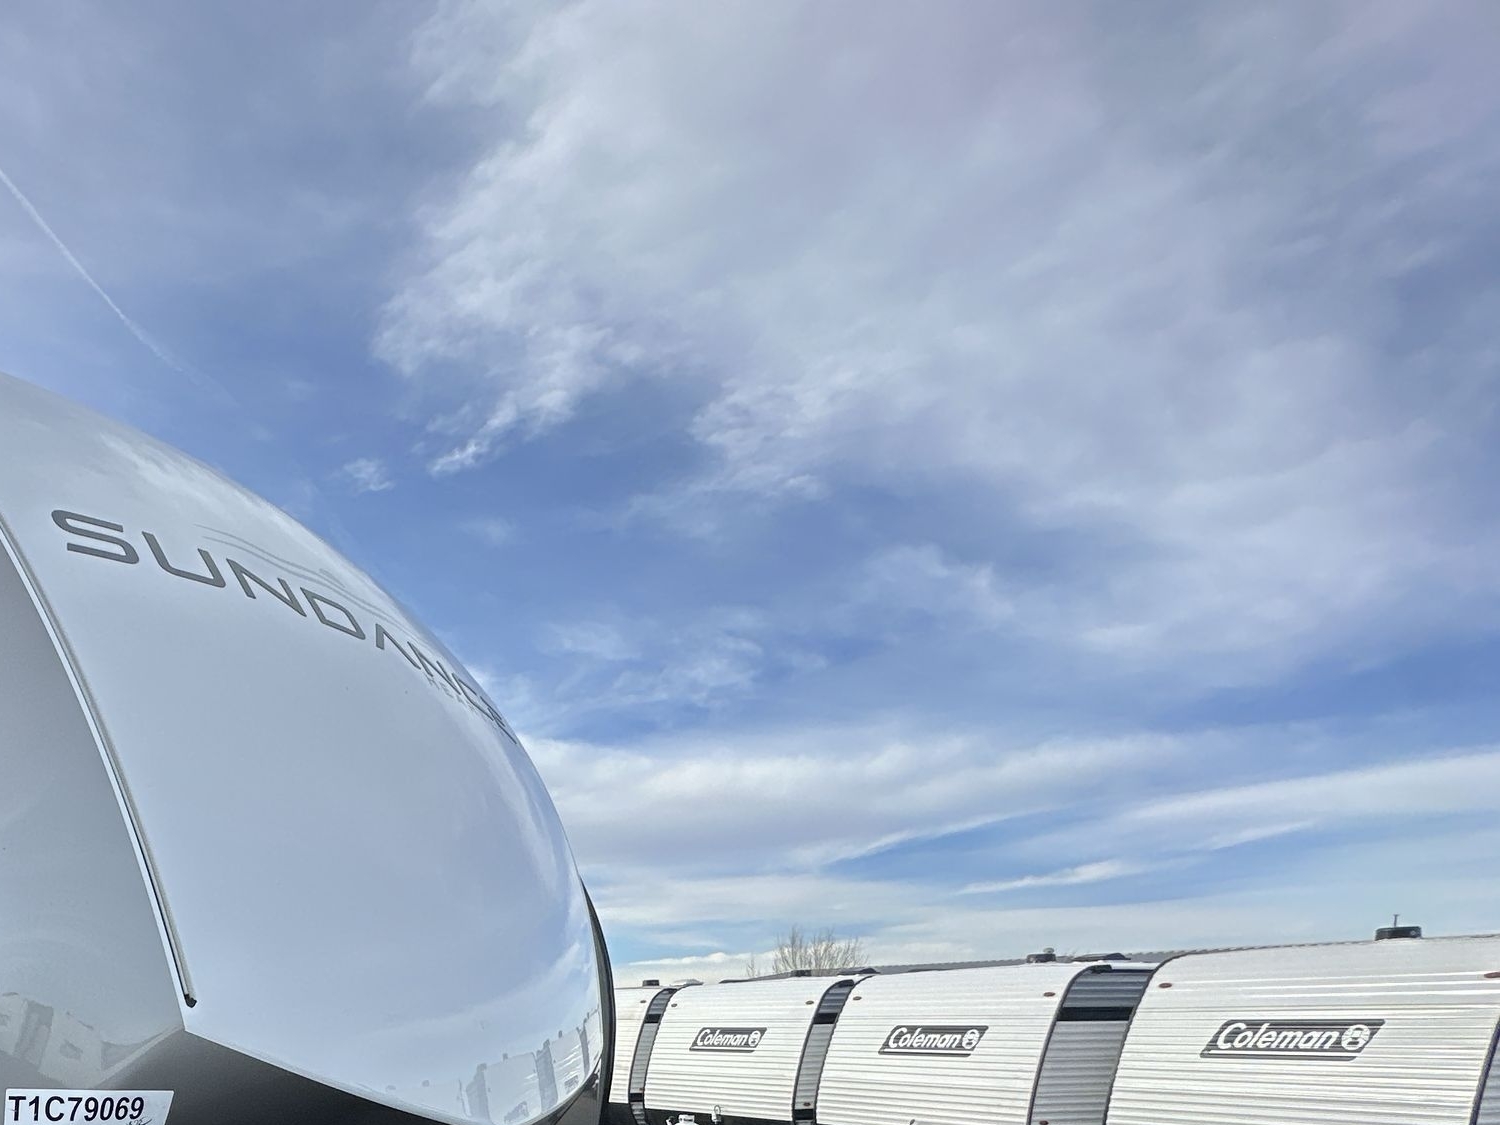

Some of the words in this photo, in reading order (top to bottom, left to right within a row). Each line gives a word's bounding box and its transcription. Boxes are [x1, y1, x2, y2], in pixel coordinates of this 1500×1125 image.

[696, 1029, 749, 1046] Coleman
[888, 1027, 962, 1048] Coleman
[1217, 1022, 1340, 1049] Coleman
[8, 1095, 145, 1122] T1C79069
